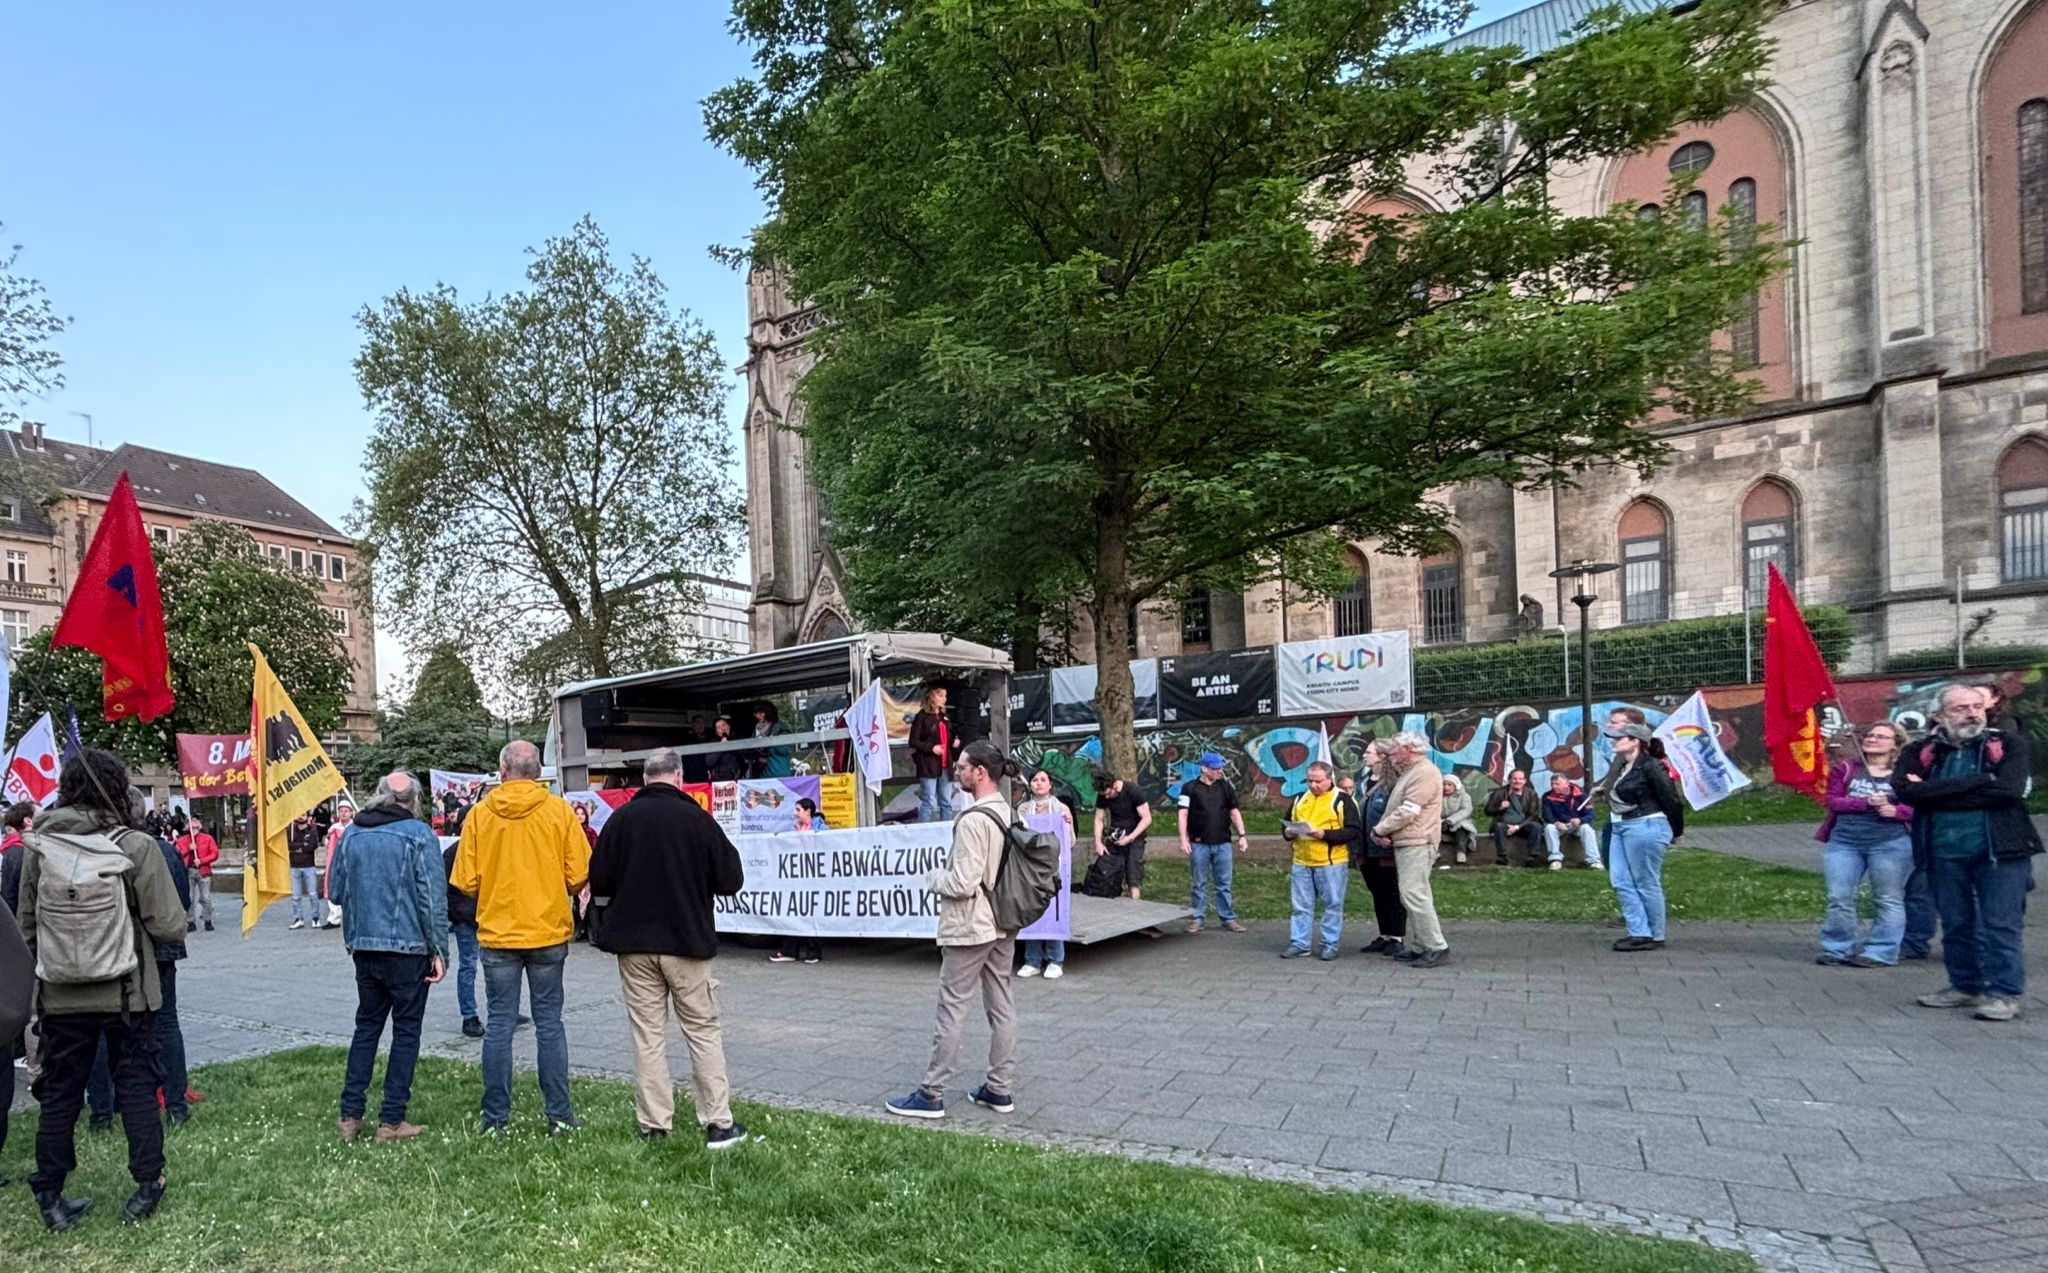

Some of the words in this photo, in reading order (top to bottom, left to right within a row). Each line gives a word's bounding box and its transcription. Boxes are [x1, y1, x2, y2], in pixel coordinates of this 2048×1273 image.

[1302, 645, 1384, 675] TRUDI
[1191, 677, 1207, 687] BE
[1211, 675, 1230, 686] AN
[1196, 684, 1239, 697] ARTIST
[208, 741, 228, 765] 8.
[714, 785, 735, 798] Verbot
[778, 852, 827, 880] KEINE
[831, 845, 947, 878] ABWÄLZUNG
[715, 890, 783, 917] SLASTEN
[786, 890, 820, 917] AUF
[823, 890, 852, 917] DIE
[856, 884, 942, 917] BEVÖLKE
